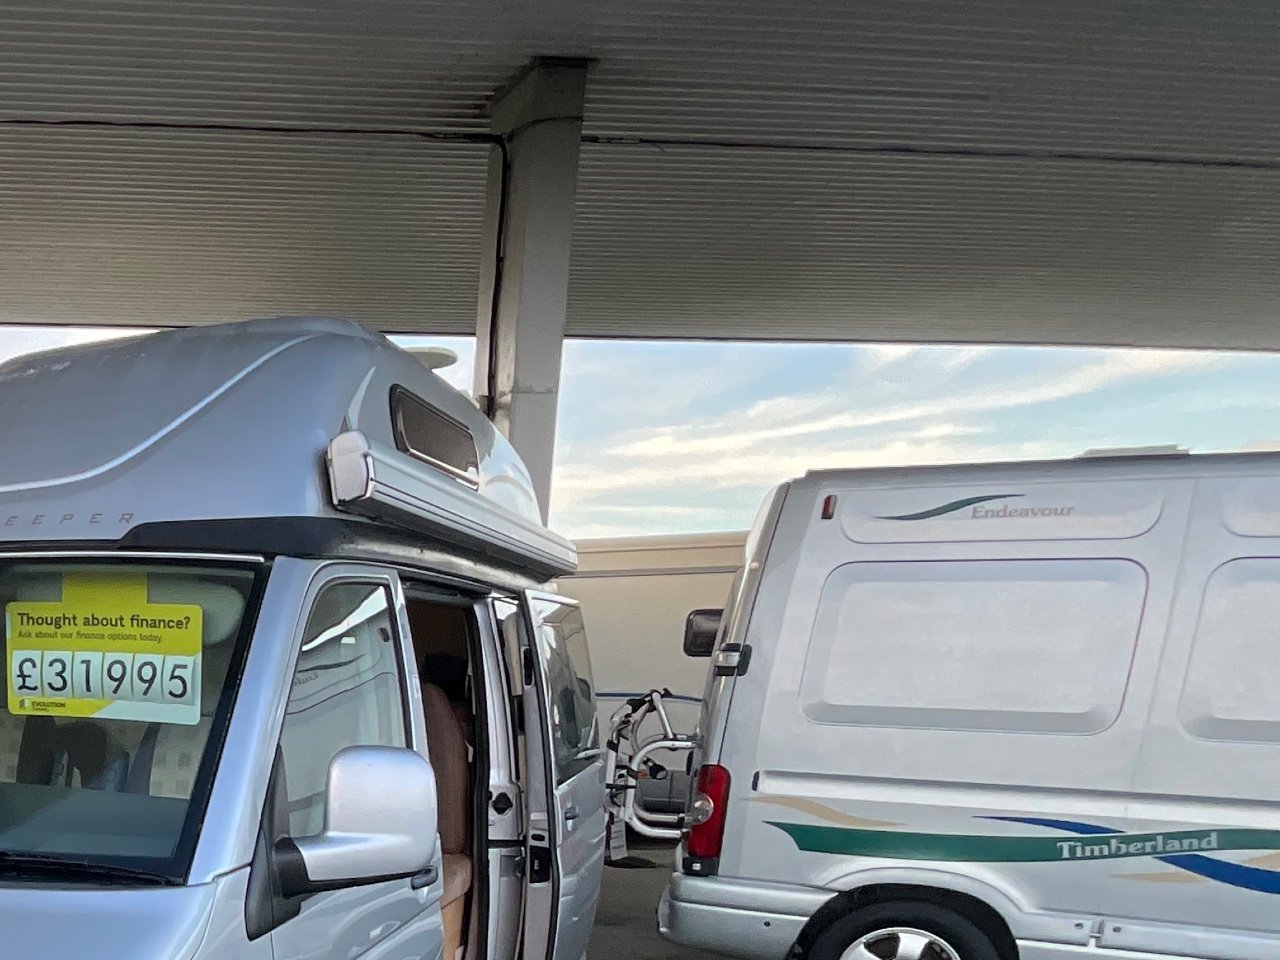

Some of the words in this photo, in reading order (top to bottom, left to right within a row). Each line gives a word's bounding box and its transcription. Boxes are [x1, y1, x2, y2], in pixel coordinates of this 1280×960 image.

[971, 504, 1075, 519] Endeavour
[17, 613, 78, 629] Thought
[83, 613, 125, 628] about
[130, 614, 191, 630] finance?
[17, 631, 32, 639] Ask
[35, 631, 58, 639] about
[60, 632, 73, 640] our
[76, 631, 105, 640] finance
[107, 632, 138, 642] options
[16, 657, 188, 699] £31995
[1056, 831, 1218, 859] Timberland
